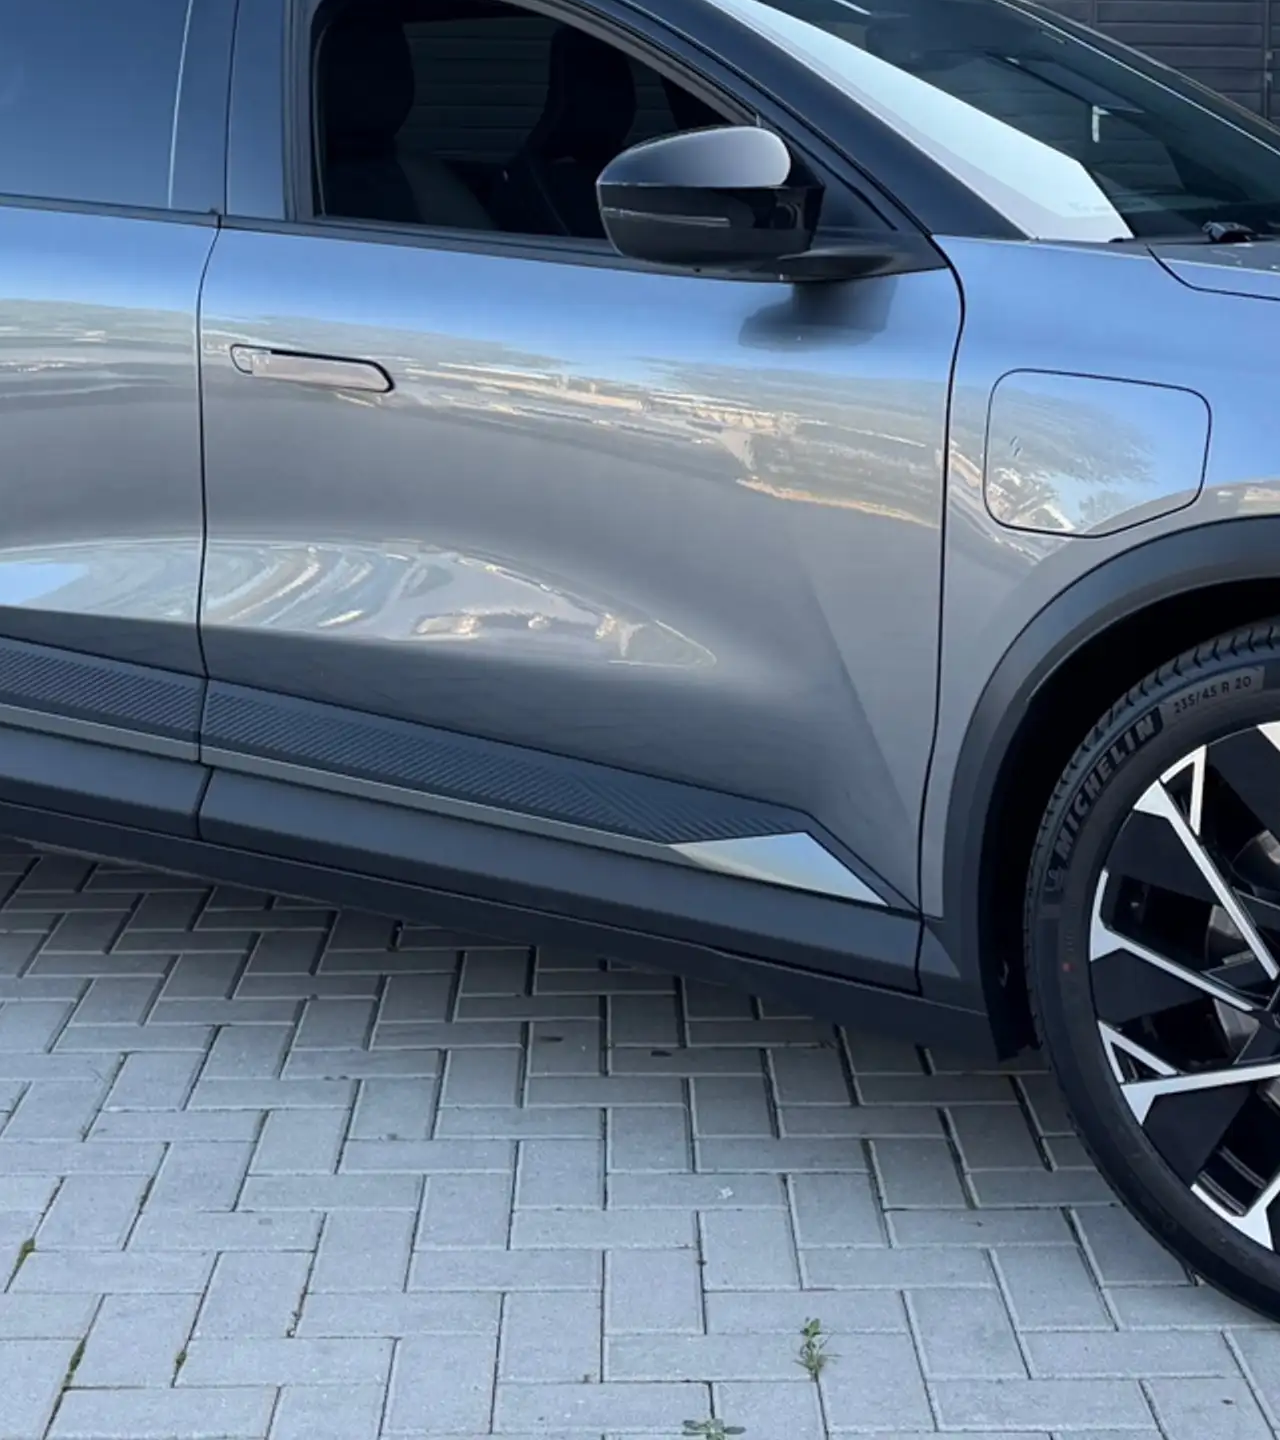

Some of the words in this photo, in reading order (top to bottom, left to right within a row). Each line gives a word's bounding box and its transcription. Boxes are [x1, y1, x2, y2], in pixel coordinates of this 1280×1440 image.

[1173, 685, 1218, 714] 235/45
[1221, 681, 1230, 694] R
[1234, 675, 1252, 691] 20
[1054, 712, 1157, 860] MICHELIN
